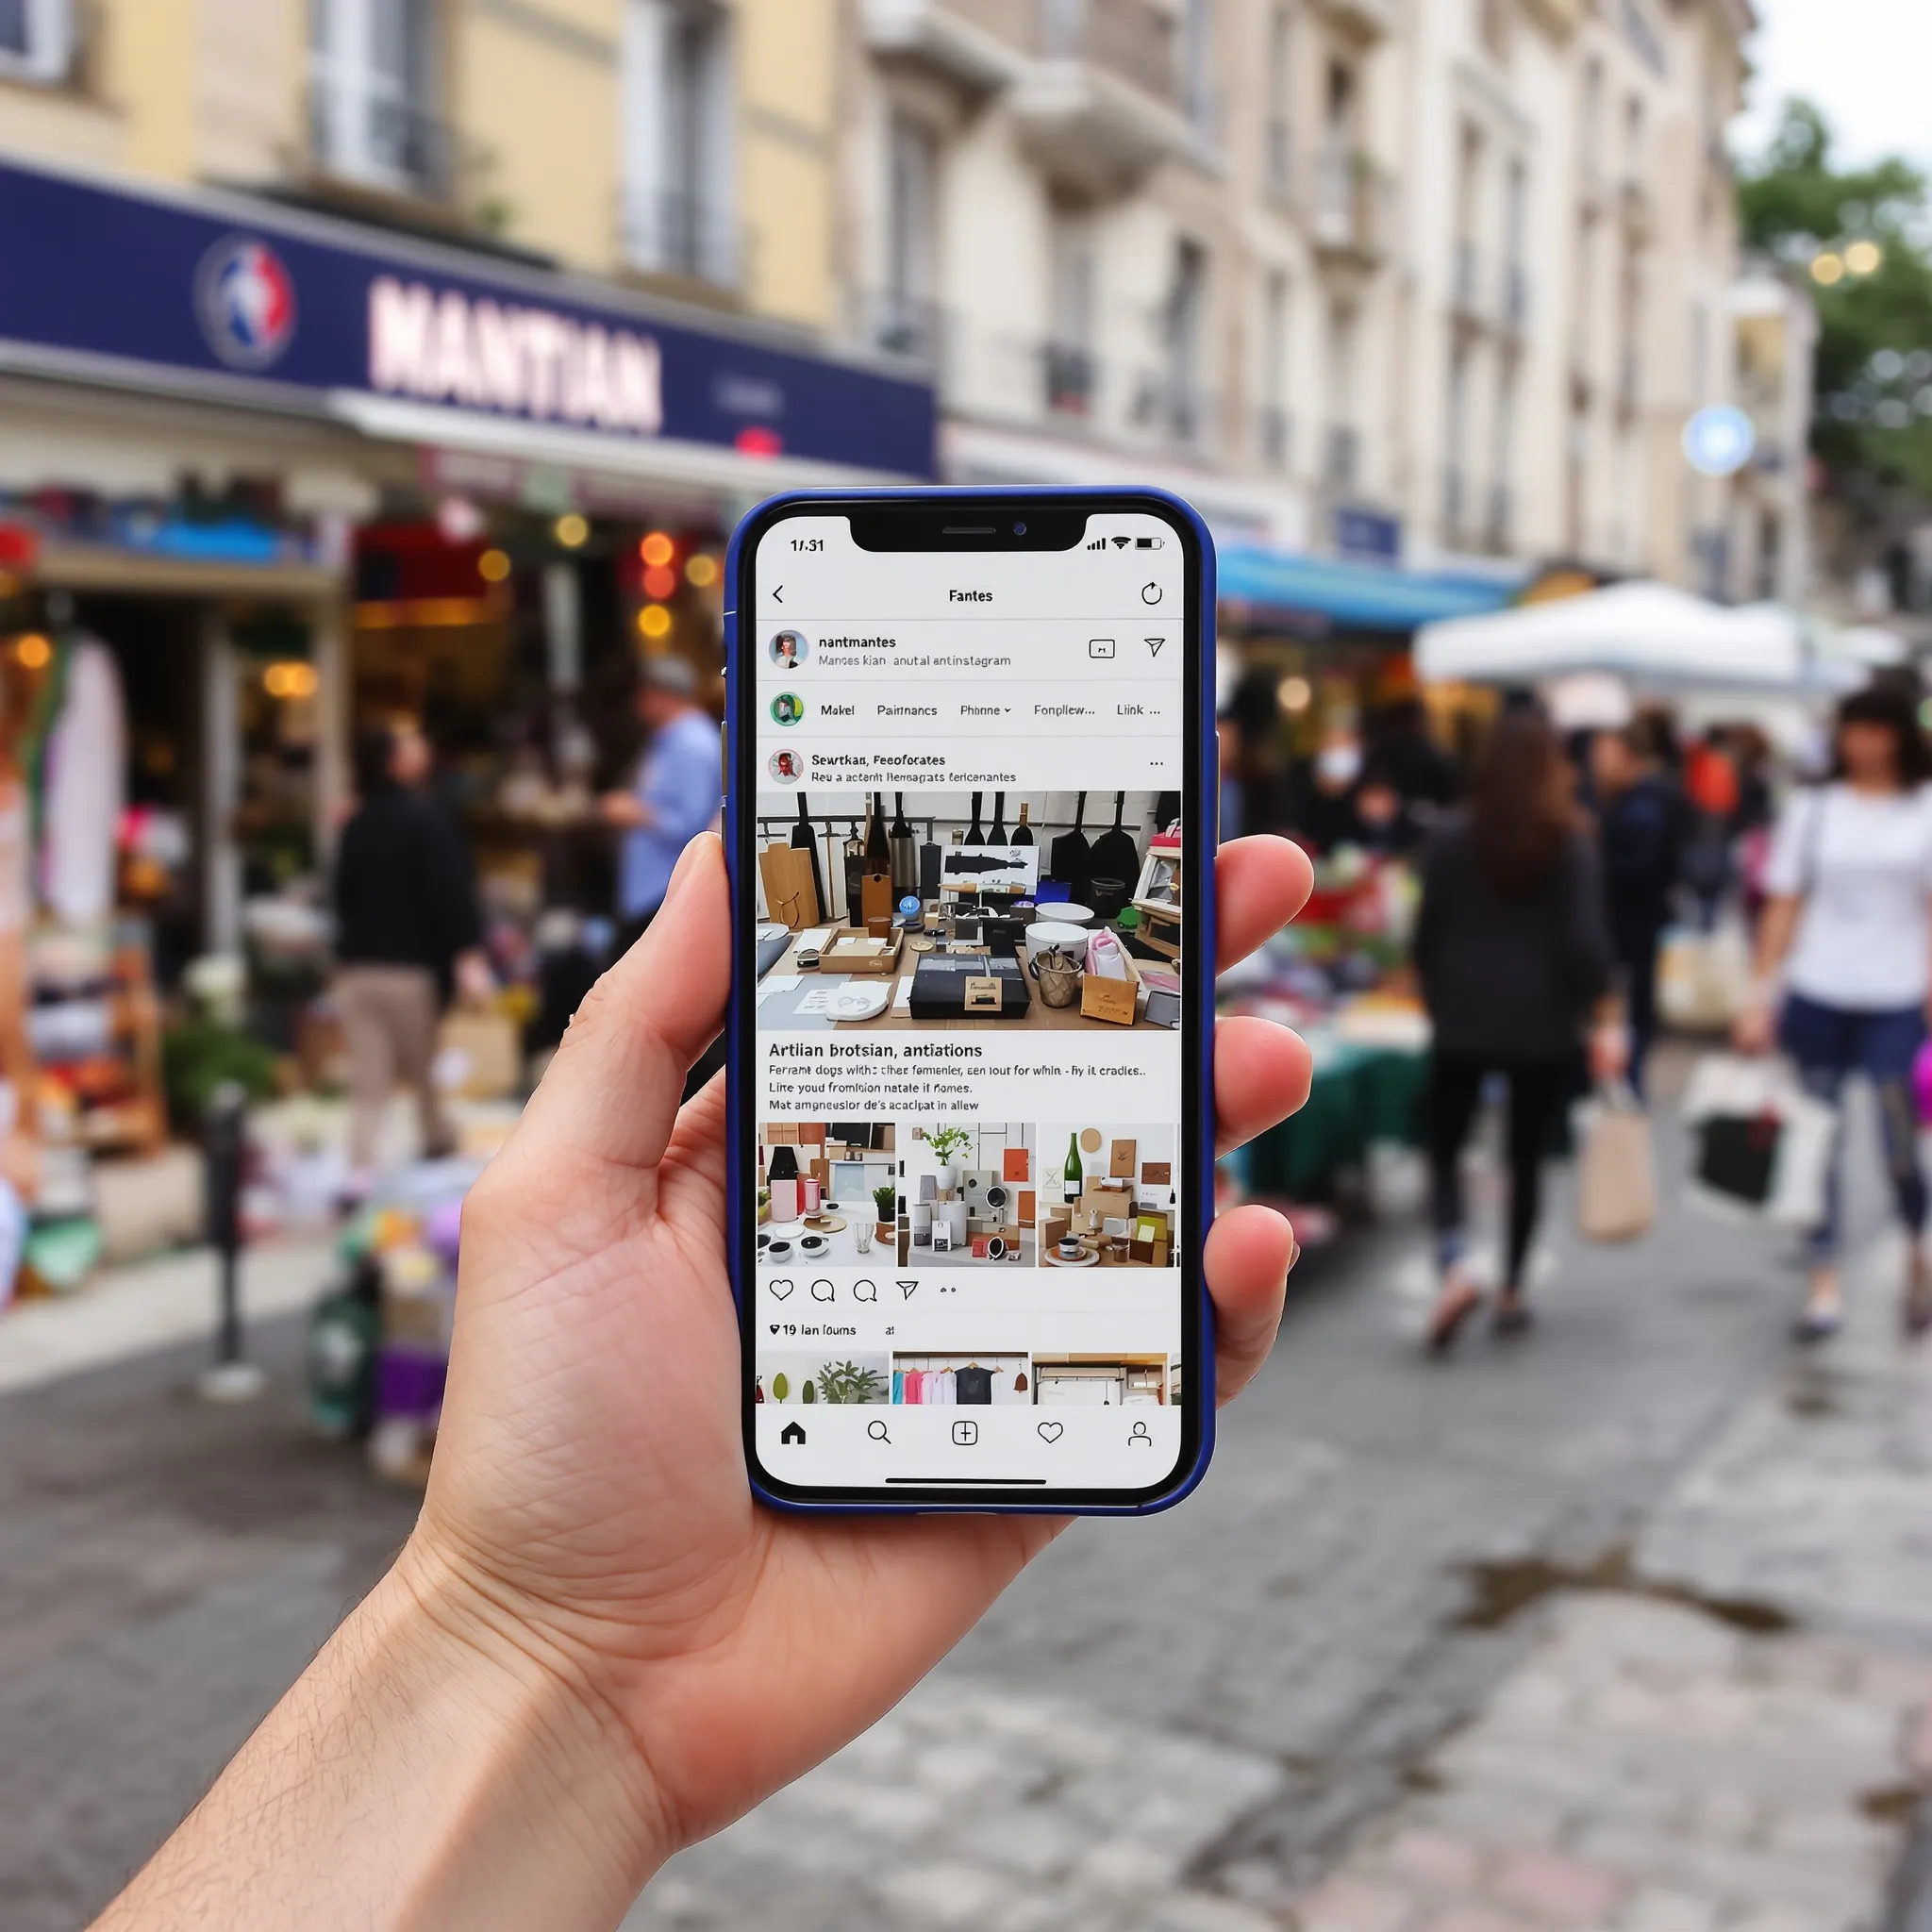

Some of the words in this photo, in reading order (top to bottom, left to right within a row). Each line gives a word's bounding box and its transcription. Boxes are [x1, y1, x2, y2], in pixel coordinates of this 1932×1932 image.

[950, 590, 992, 602] Fantes
[819, 637, 896, 648] nantmantes
[1014, 1065, 1030, 1075] for
